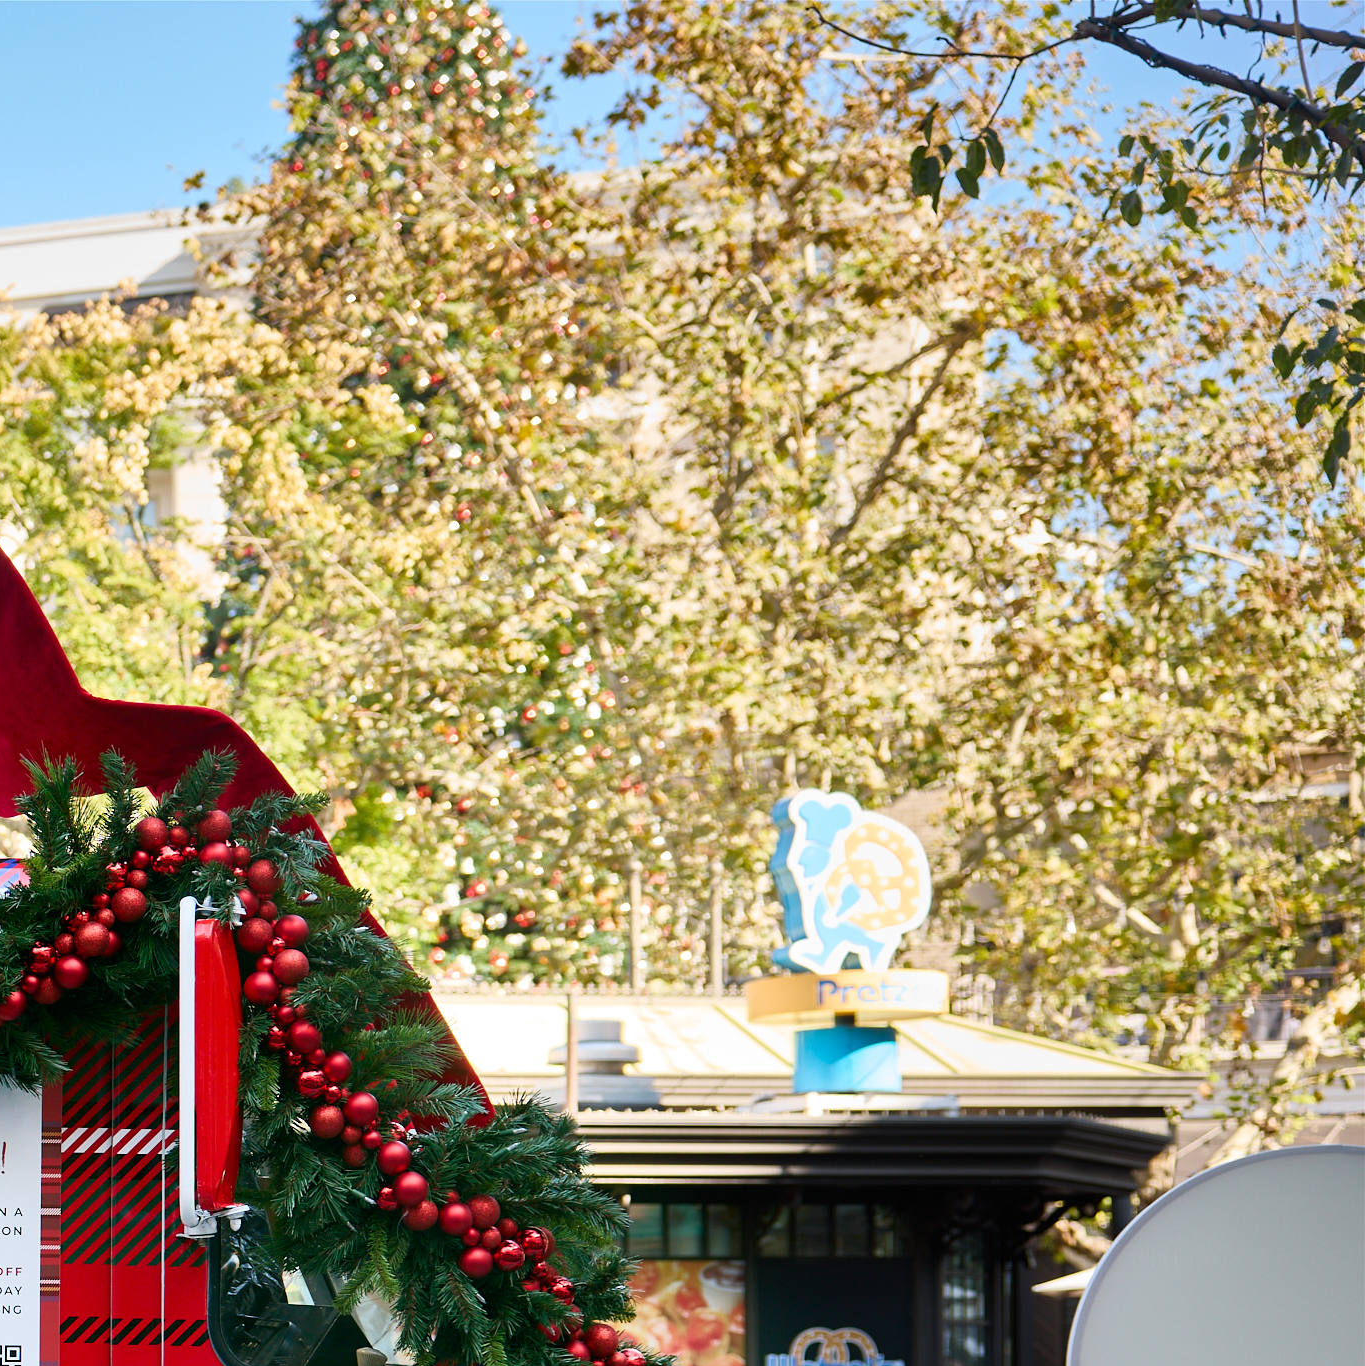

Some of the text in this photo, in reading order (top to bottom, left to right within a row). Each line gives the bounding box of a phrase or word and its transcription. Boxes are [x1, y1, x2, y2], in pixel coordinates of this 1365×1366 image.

[817, 980, 924, 1005] Pretz
[14, 1206, 24, 1217] A
[1, 1225, 23, 1236] ON
